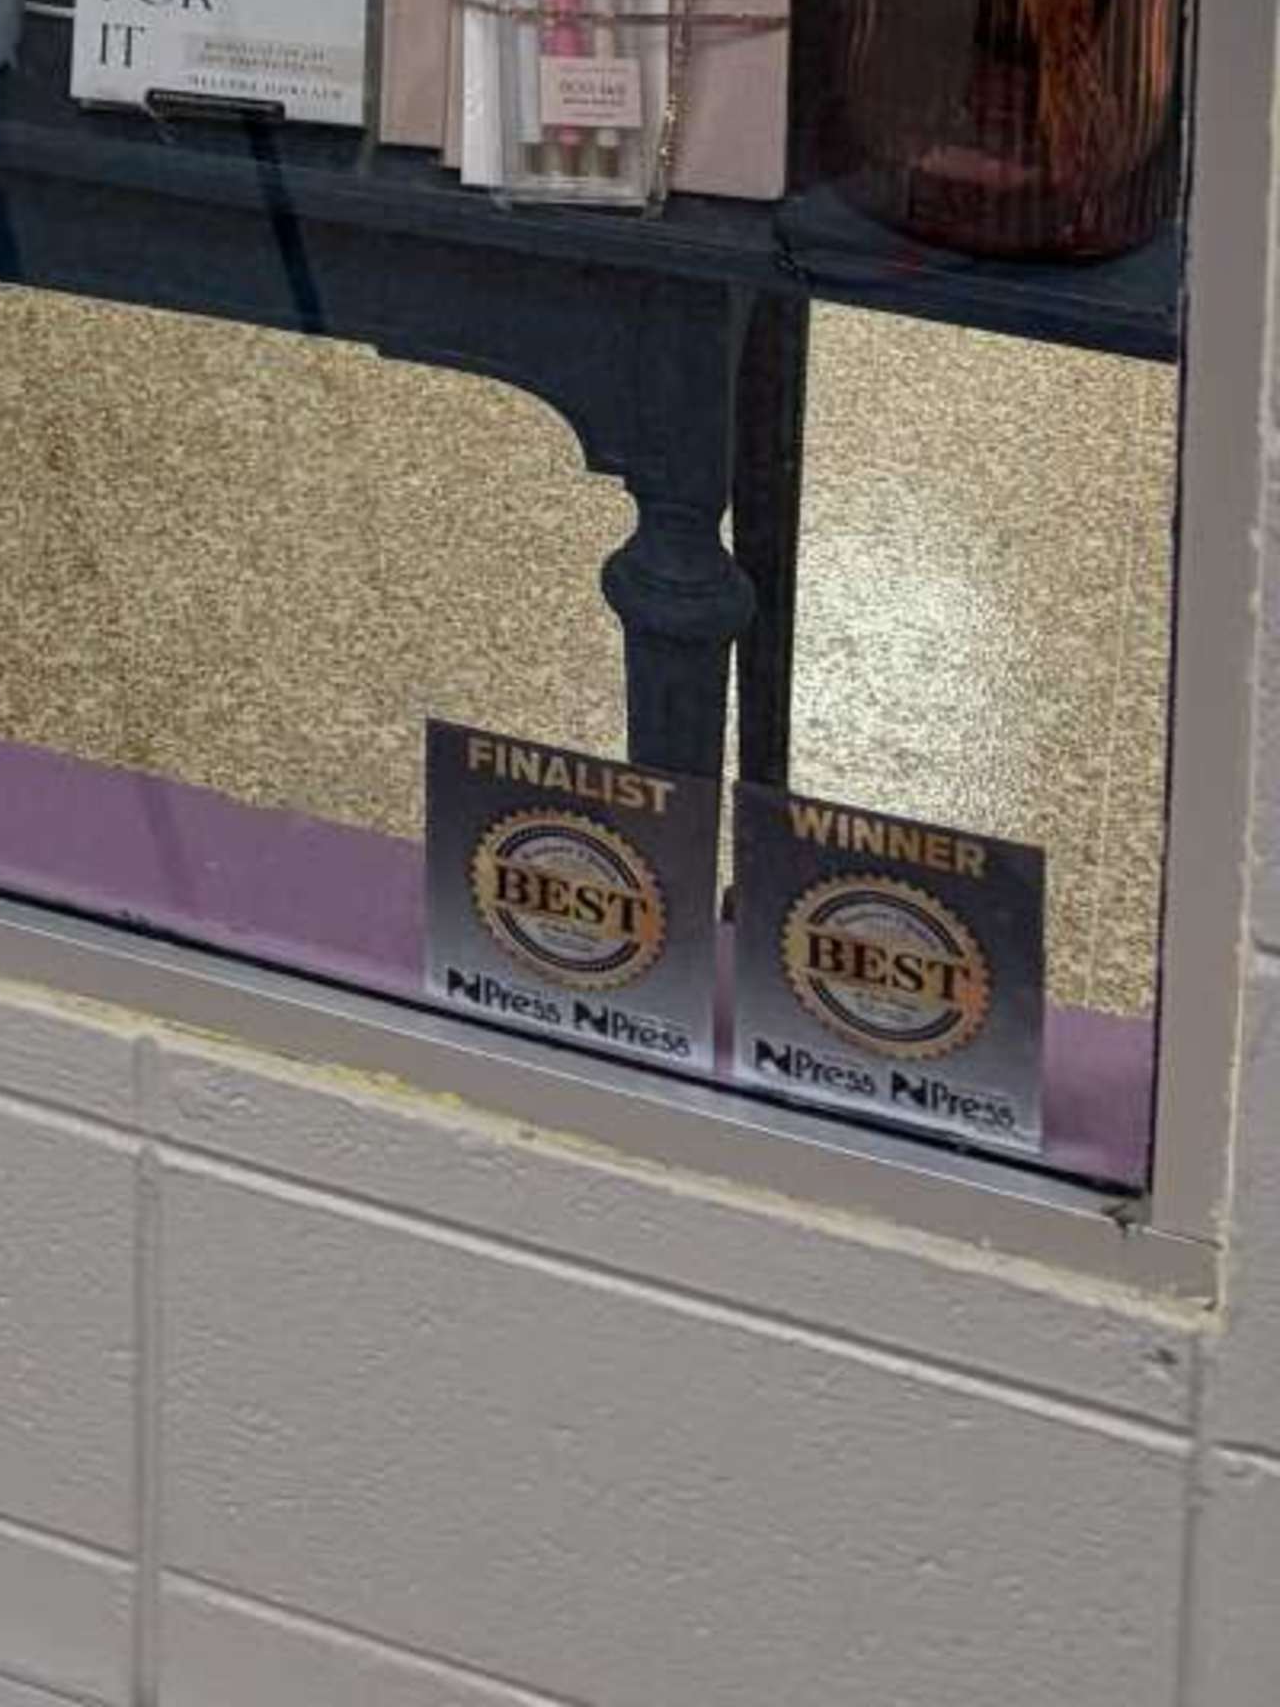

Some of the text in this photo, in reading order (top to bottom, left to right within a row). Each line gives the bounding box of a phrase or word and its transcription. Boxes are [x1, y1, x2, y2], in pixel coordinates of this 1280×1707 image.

[99, 22, 147, 69] IT
[468, 735, 676, 814] FINALIST
[790, 800, 987, 879] WINNER
[495, 865, 648, 935] BEST
[807, 933, 971, 1003] BEST
